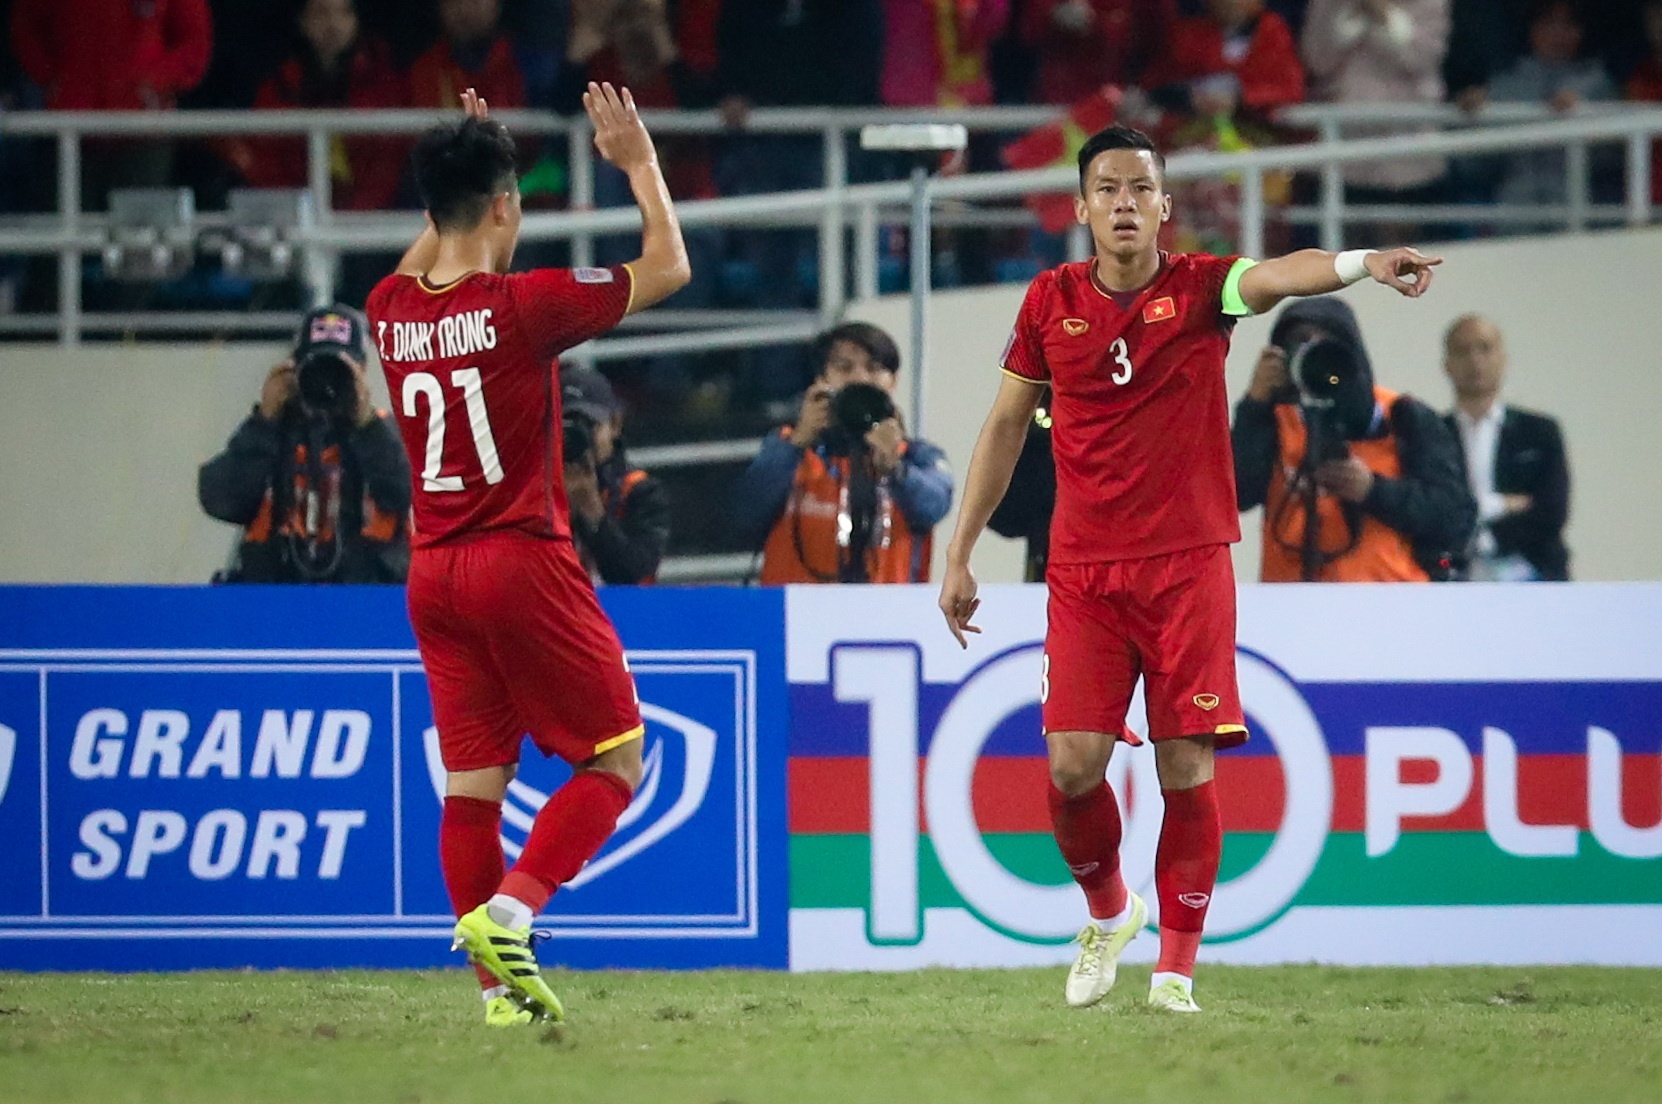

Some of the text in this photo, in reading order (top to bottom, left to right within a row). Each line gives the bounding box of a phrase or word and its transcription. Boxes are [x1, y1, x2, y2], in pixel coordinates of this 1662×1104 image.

[393, 321, 435, 362] DINH
[437, 308, 497, 359] TRONG
[1109, 336, 1133, 385] 3
[402, 366, 505, 491] 21
[68, 708, 373, 780] GRAND
[70, 809, 367, 880] SPORT
